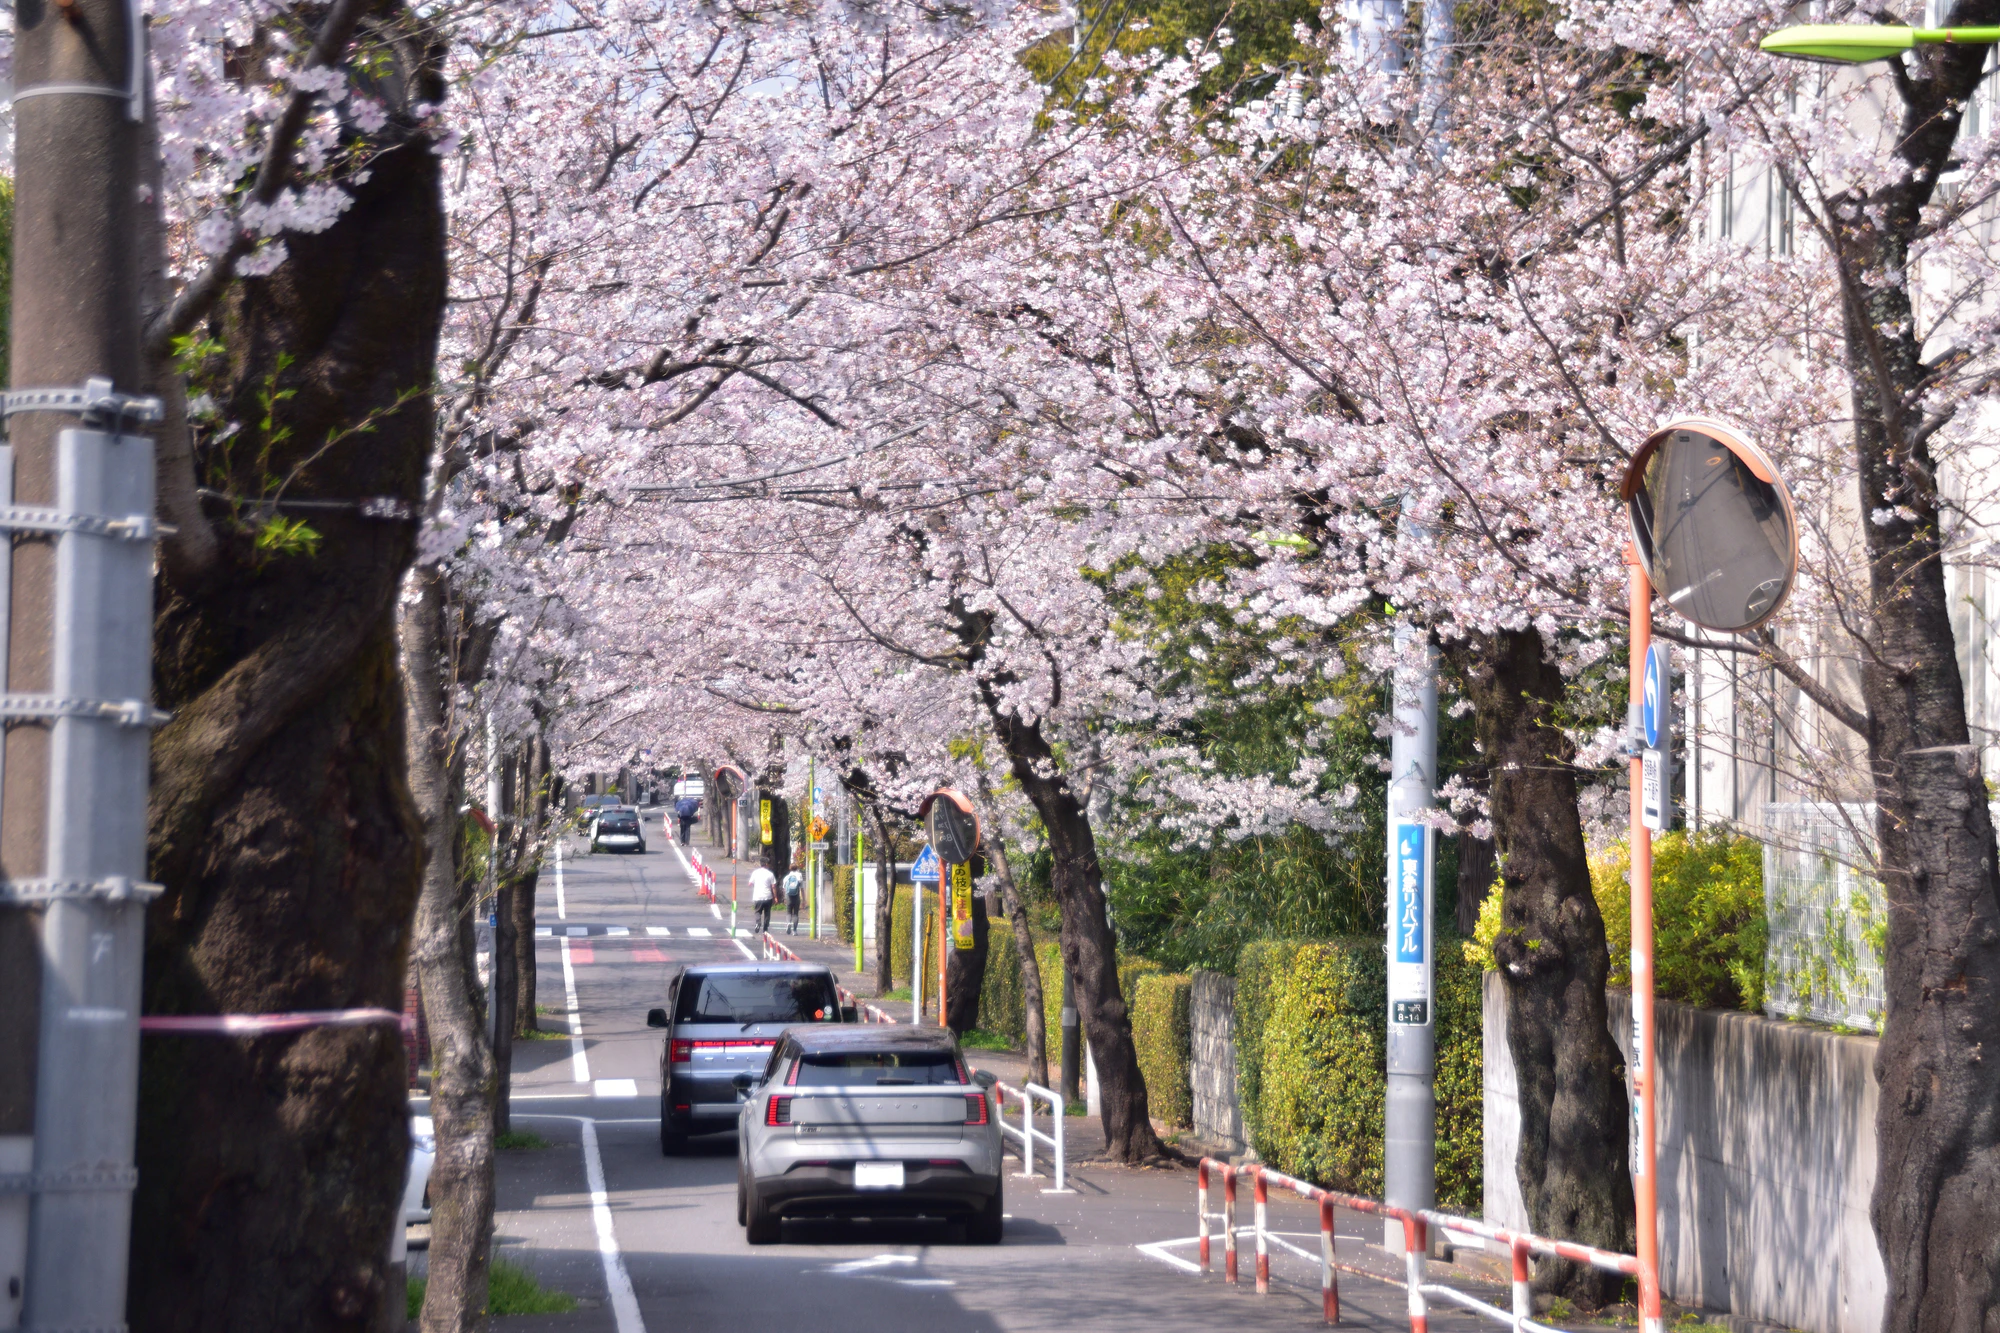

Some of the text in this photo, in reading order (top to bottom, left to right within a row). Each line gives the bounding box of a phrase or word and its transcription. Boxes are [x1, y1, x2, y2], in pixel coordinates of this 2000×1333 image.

[1401, 859, 1418, 953] 東急リバブル
